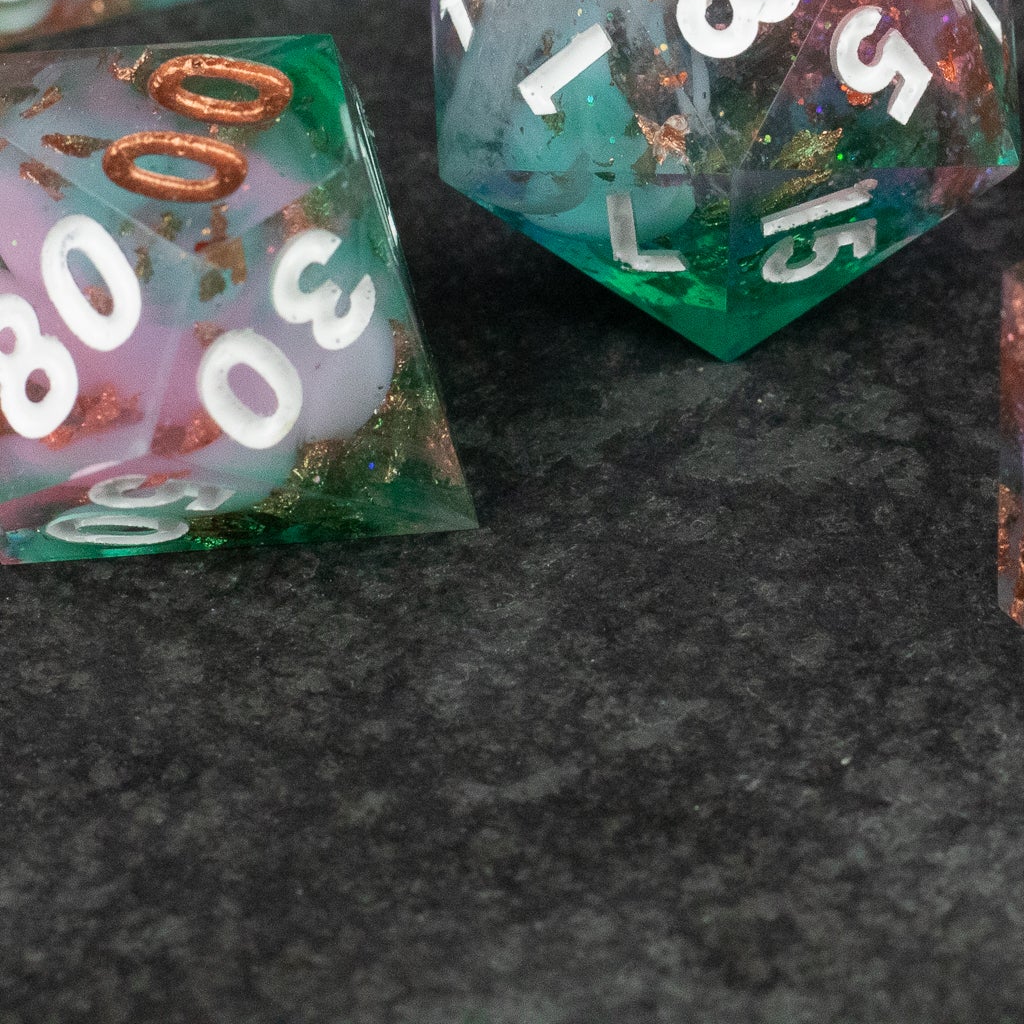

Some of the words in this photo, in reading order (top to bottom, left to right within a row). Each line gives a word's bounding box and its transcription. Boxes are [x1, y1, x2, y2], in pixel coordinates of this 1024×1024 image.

[830, 5, 933, 126] 5
[103, 52, 293, 203] 00
[606, 191, 690, 272] 7
[760, 178, 878, 284] 15
